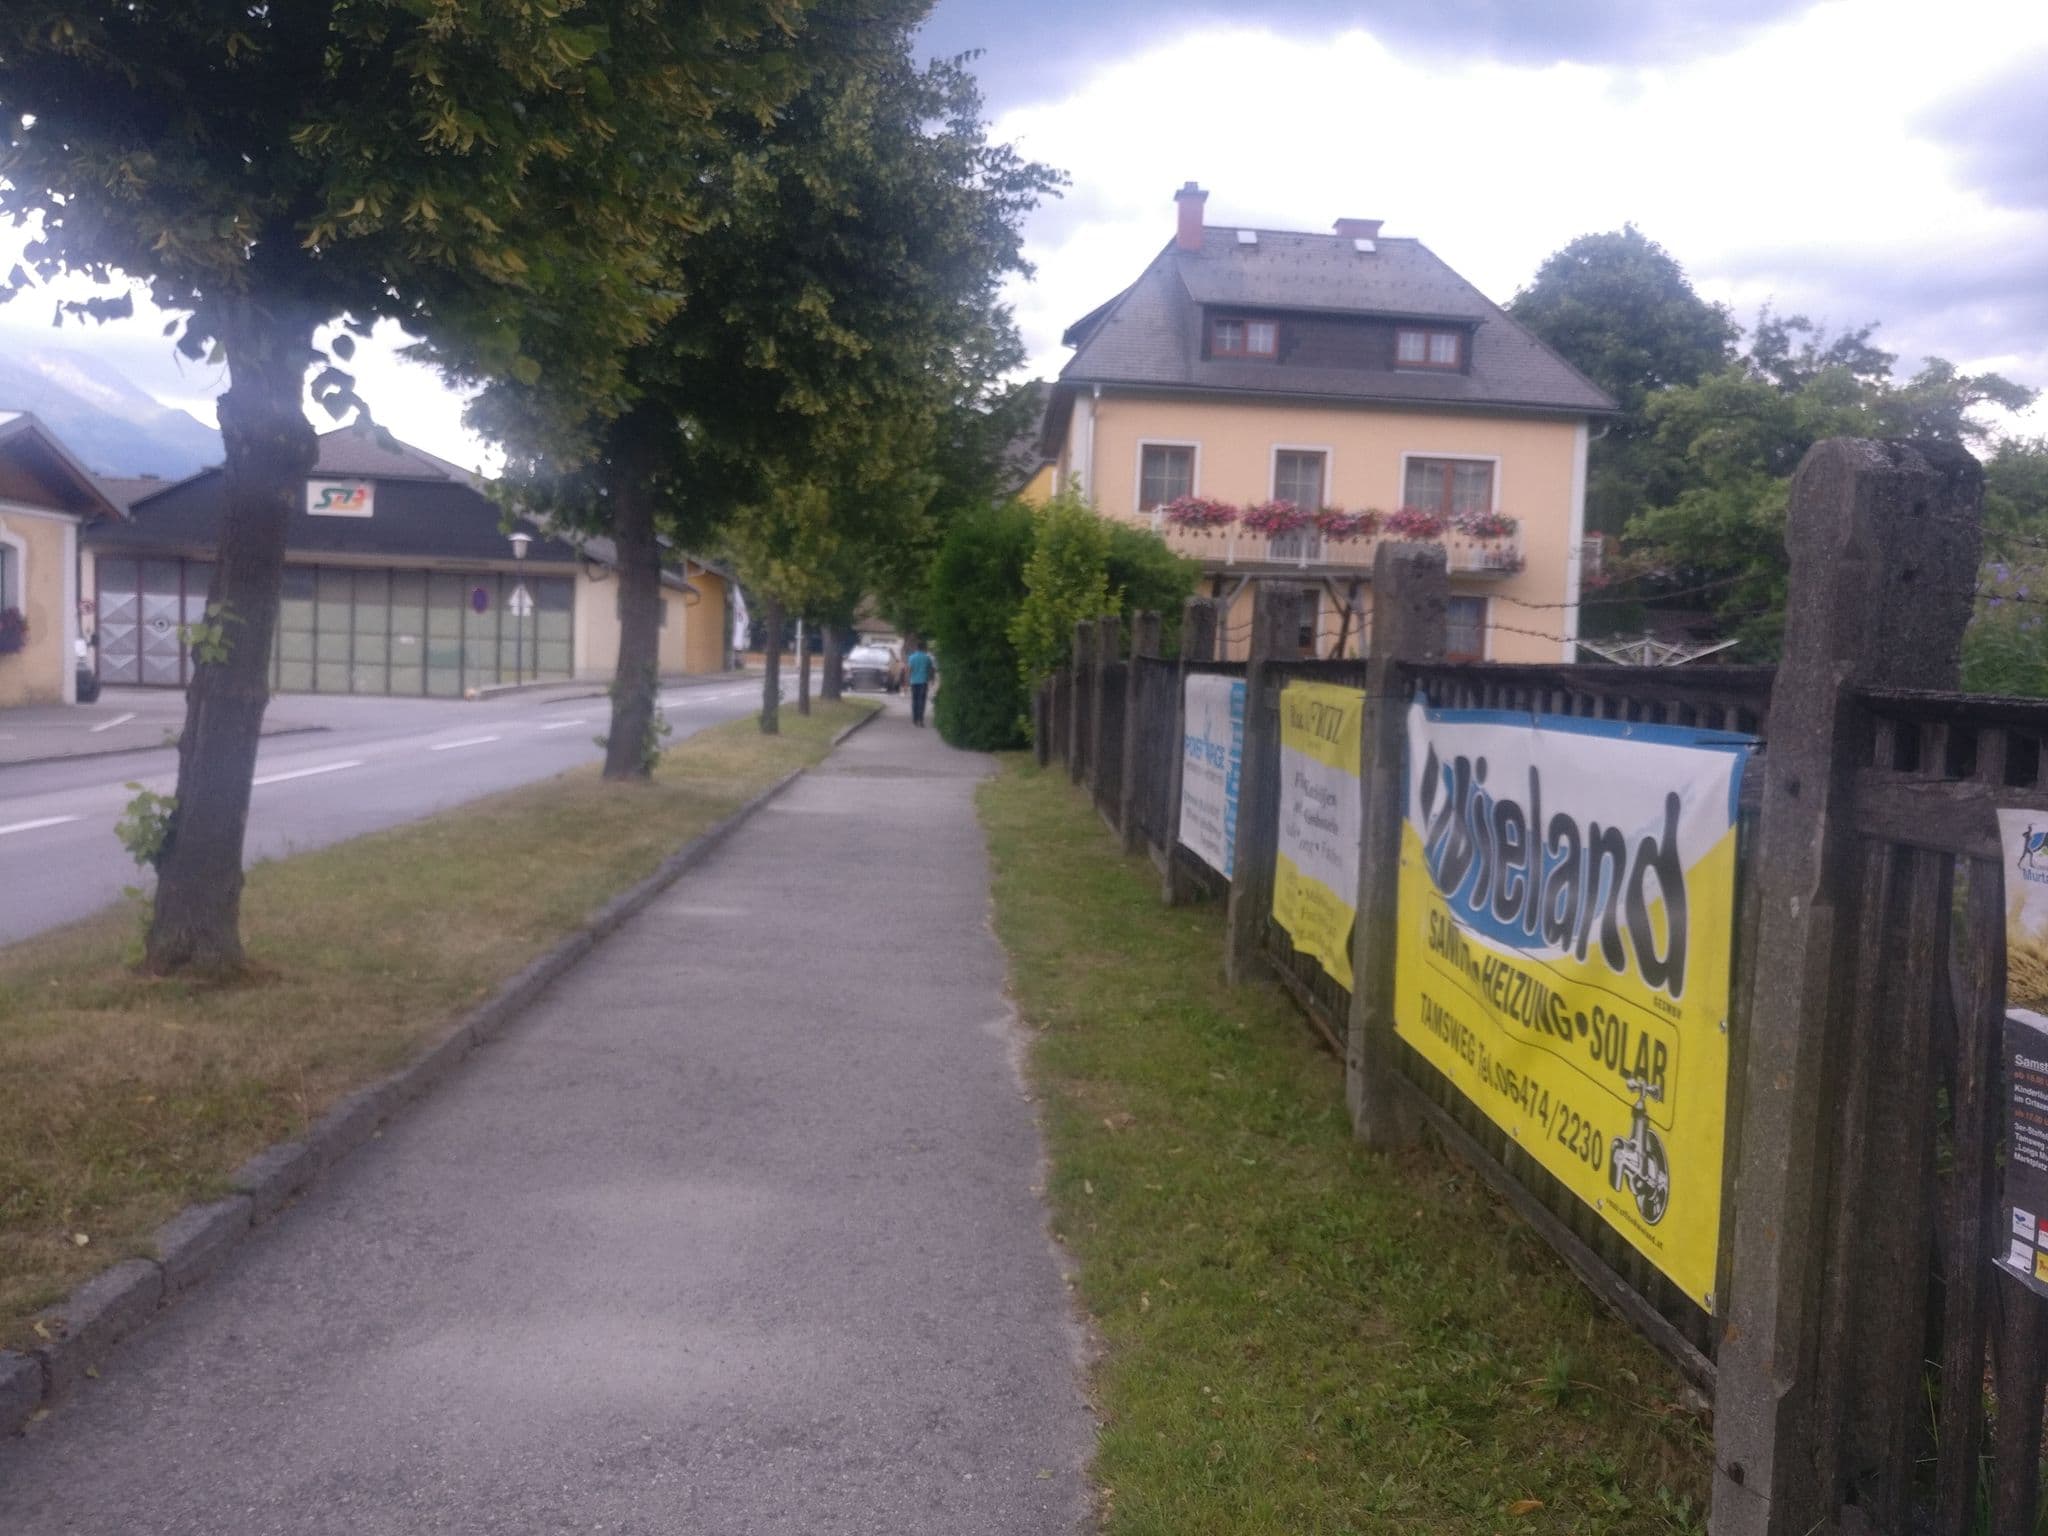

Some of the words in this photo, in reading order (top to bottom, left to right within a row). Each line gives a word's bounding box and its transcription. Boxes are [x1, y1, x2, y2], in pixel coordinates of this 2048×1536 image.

[1421, 741, 1686, 1000] Wieland
[1420, 991, 1475, 1067] TAMSWEG
[1590, 1005, 1667, 1104] SOLAR
